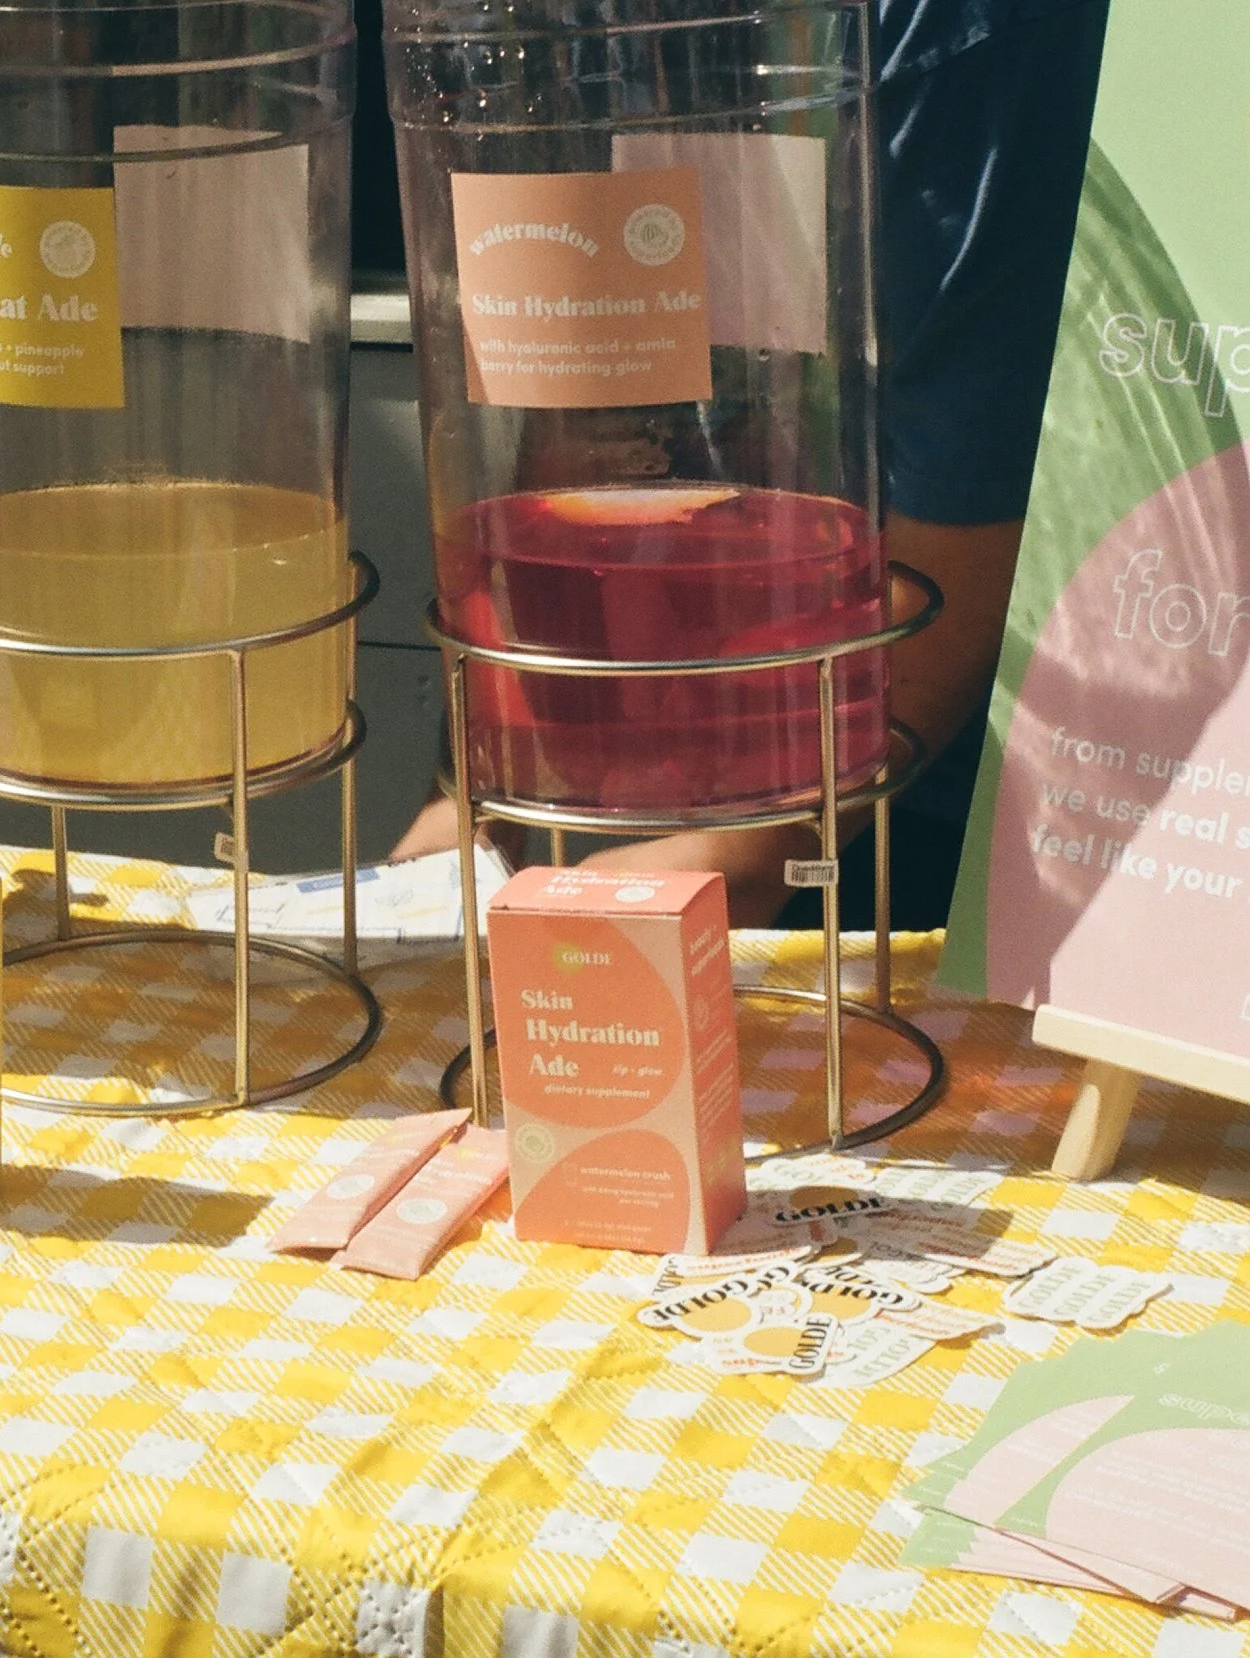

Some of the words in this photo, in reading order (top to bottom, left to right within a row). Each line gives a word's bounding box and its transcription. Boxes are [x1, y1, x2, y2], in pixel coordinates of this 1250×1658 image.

[469, 222, 599, 258] watermelon
[38, 293, 98, 322] Ade
[472, 294, 517, 316] Skin
[524, 295, 646, 322] Hydration
[654, 291, 702, 312] Ade
[15, 341, 84, 359] pineapple
[479, 339, 506, 352] with
[508, 339, 581, 357] hyaluronic
[586, 338, 619, 353] acid
[636, 338, 677, 350] amla
[13, 363, 64, 377] support
[479, 360, 515, 376] berry
[516, 360, 536, 375] for
[538, 358, 611, 377] hydrating
[616, 359, 652, 376] glow
[1051, 726, 1126, 769] from
[1136, 751, 1250, 796] supple
[1041, 785, 1086, 813] we
[1097, 796, 1150, 826] use
[1158, 809, 1230, 845] real
[1026, 823, 1095, 865] feel
[1100, 837, 1156, 880] like
[1165, 862, 1244, 899] your
[521, 988, 573, 1010] Skin
[526, 1018, 660, 1047] Hydration
[529, 1052, 580, 1078] Ade
[544, 1083, 584, 1097] dietary
[585, 1085, 651, 1099] supplement
[775, 1197, 885, 1222] GOLDE
[645, 1280, 749, 1322] GOLDE
[789, 1317, 832, 1369] GOLDE
